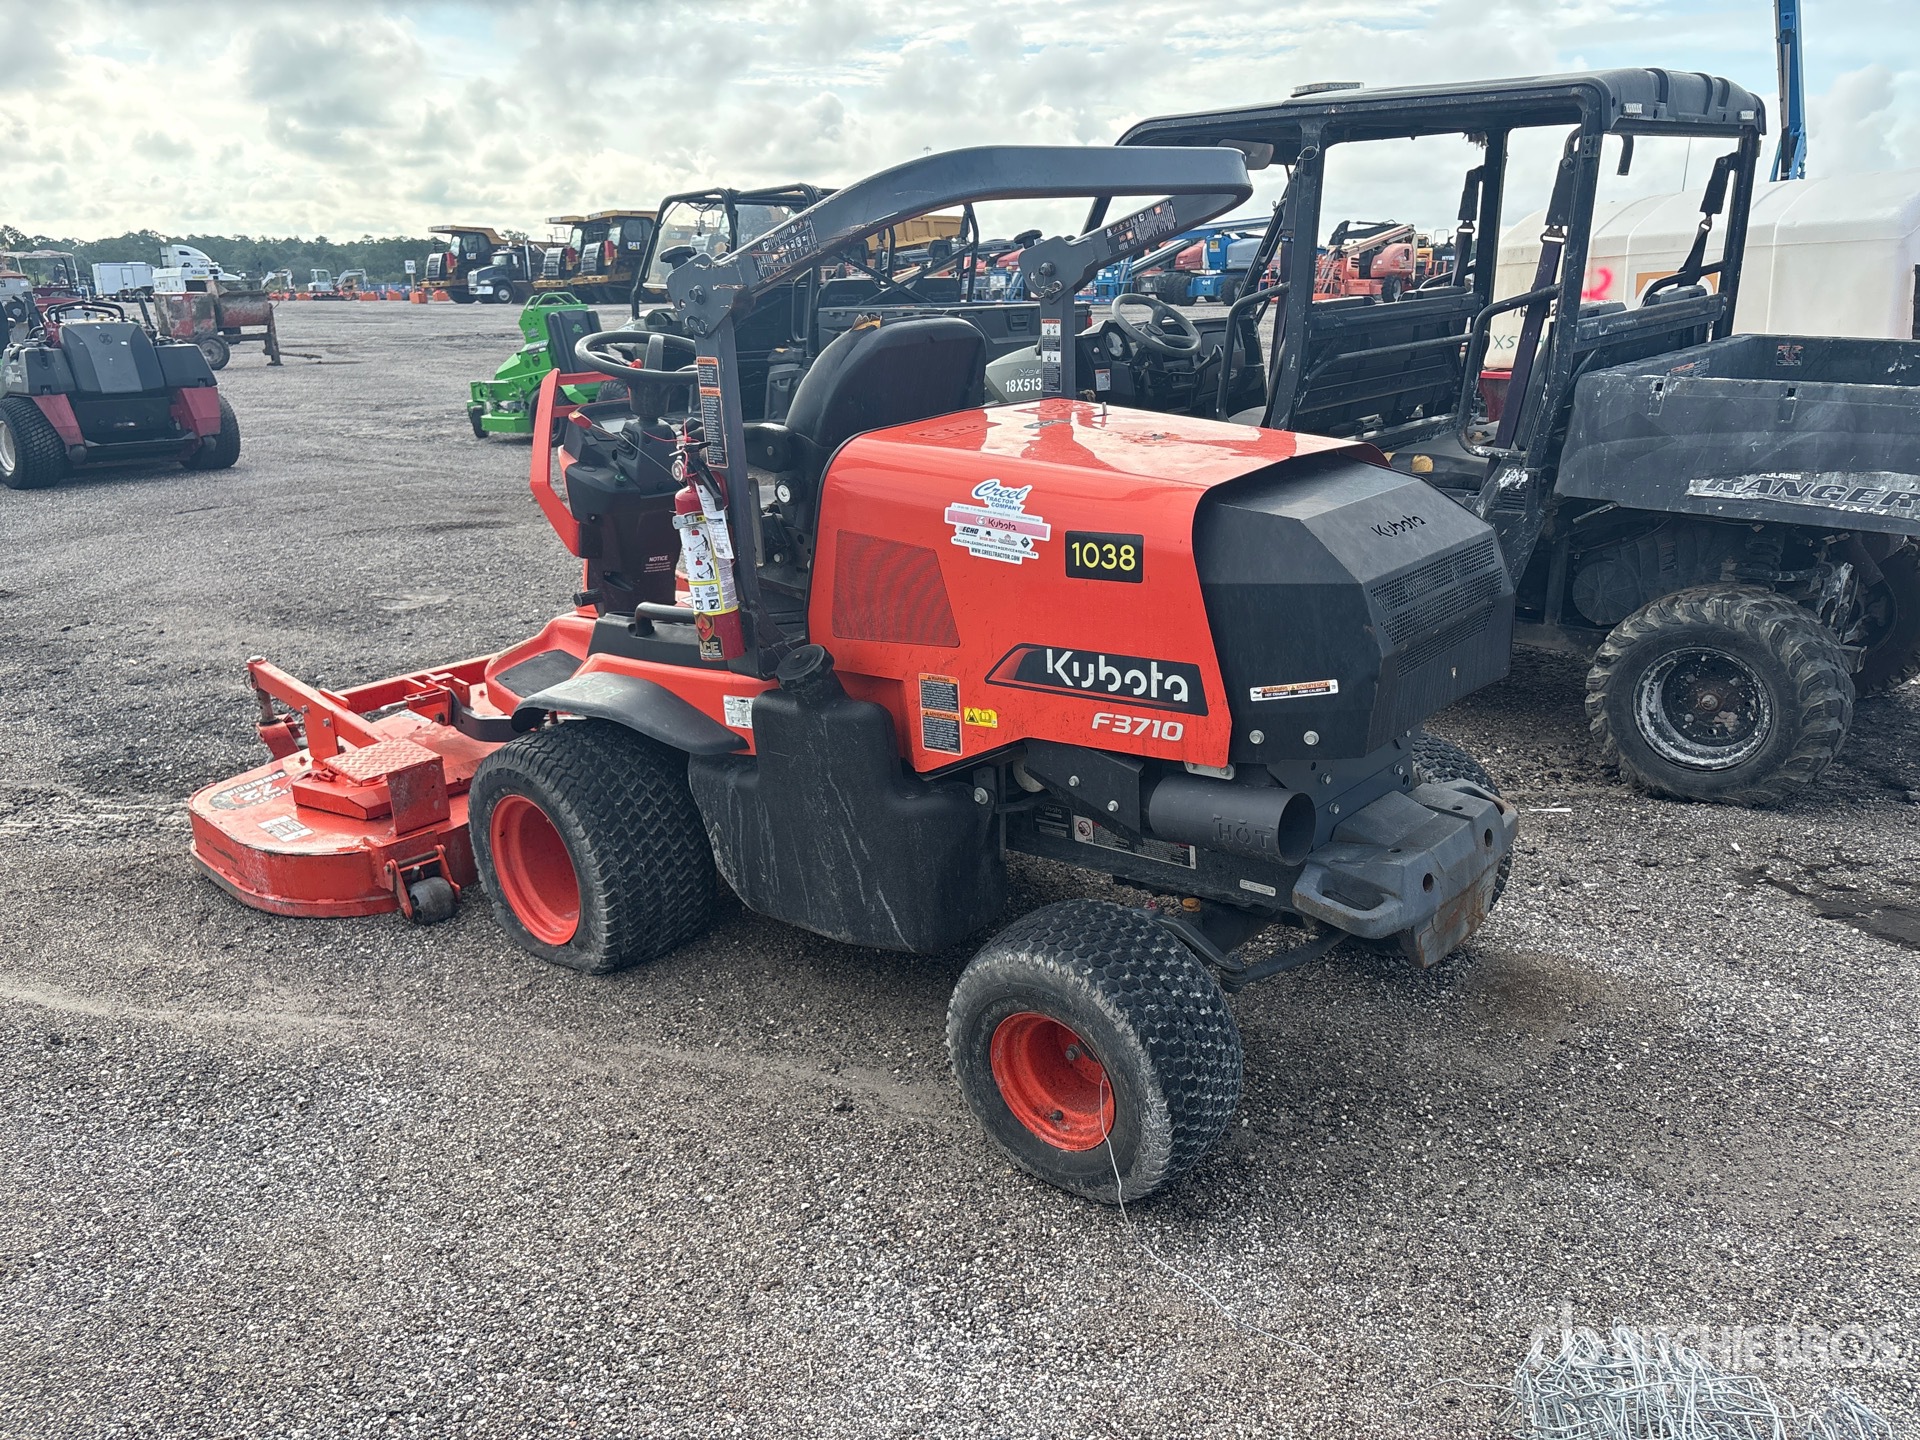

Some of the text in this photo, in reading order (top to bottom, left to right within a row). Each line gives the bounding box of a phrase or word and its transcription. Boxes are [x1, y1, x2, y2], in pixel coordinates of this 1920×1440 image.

[627, 241, 641, 250] CAT
[1005, 377, 1042, 393] 18X513
[974, 481, 1028, 500] Creel
[986, 496, 1014, 504] TRACTOR
[1704, 477, 1920, 509] RANGER
[991, 502, 1021, 511] COMPANY
[962, 526, 979, 535] ECHO
[988, 518, 1017, 531] Kubota
[1370, 514, 1426, 538] Kubota
[1071, 542, 1136, 572] 1038
[1046, 648, 1189, 703] Kubota
[1091, 712, 1184, 741] F3710
[1217, 820, 1272, 849] HOT
